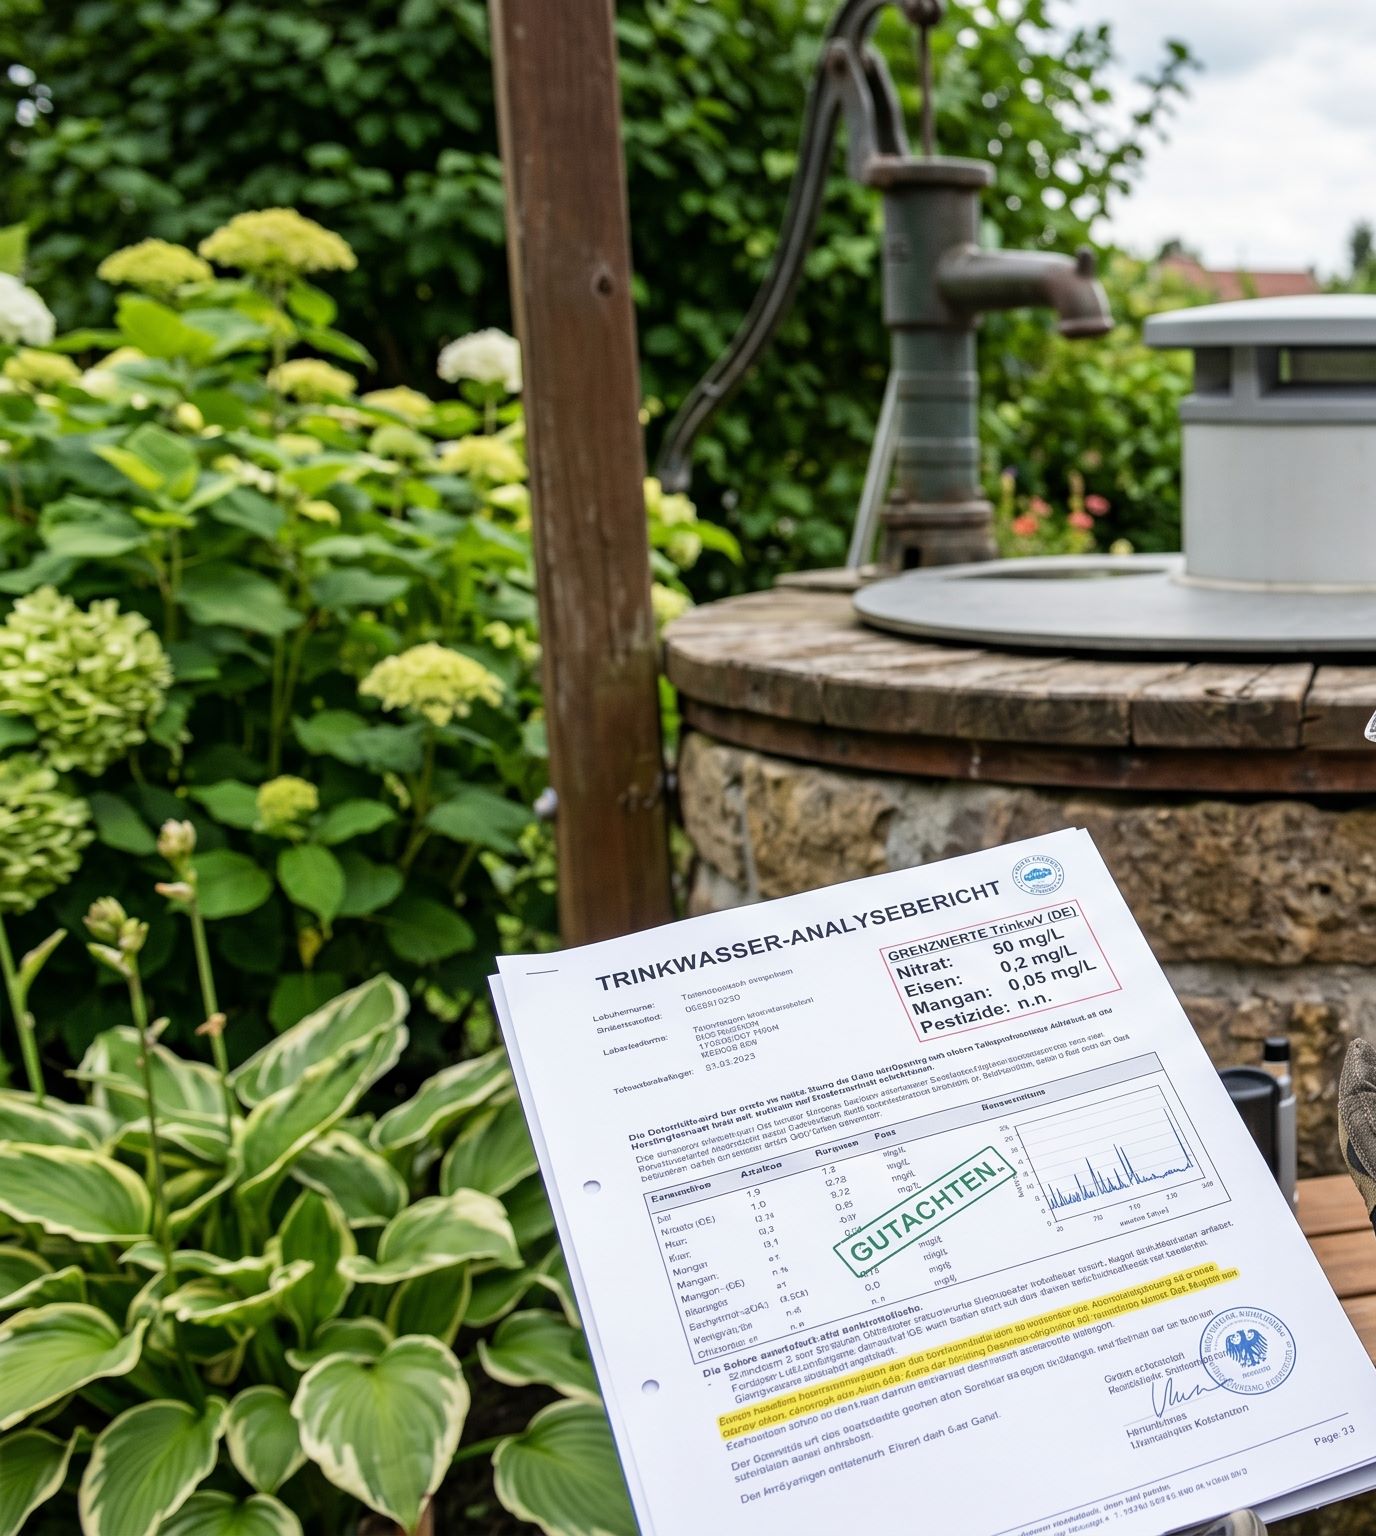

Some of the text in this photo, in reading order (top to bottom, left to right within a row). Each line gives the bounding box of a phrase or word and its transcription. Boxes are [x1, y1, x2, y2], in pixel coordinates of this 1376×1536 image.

[594, 879, 999, 991] TRINKWASSER-ANALYSEBERICHT
[887, 905, 1079, 961] GRENZWERTE TrinkwV (DE)
[895, 927, 1065, 979] Nitrat: 50 mg/L
[903, 944, 1077, 997] Eisen: 0,2 mg/L
[911, 959, 1097, 1015] Mangan: 0,05 mg/L
[919, 994, 1052, 1033] Pestizide: n.n.
